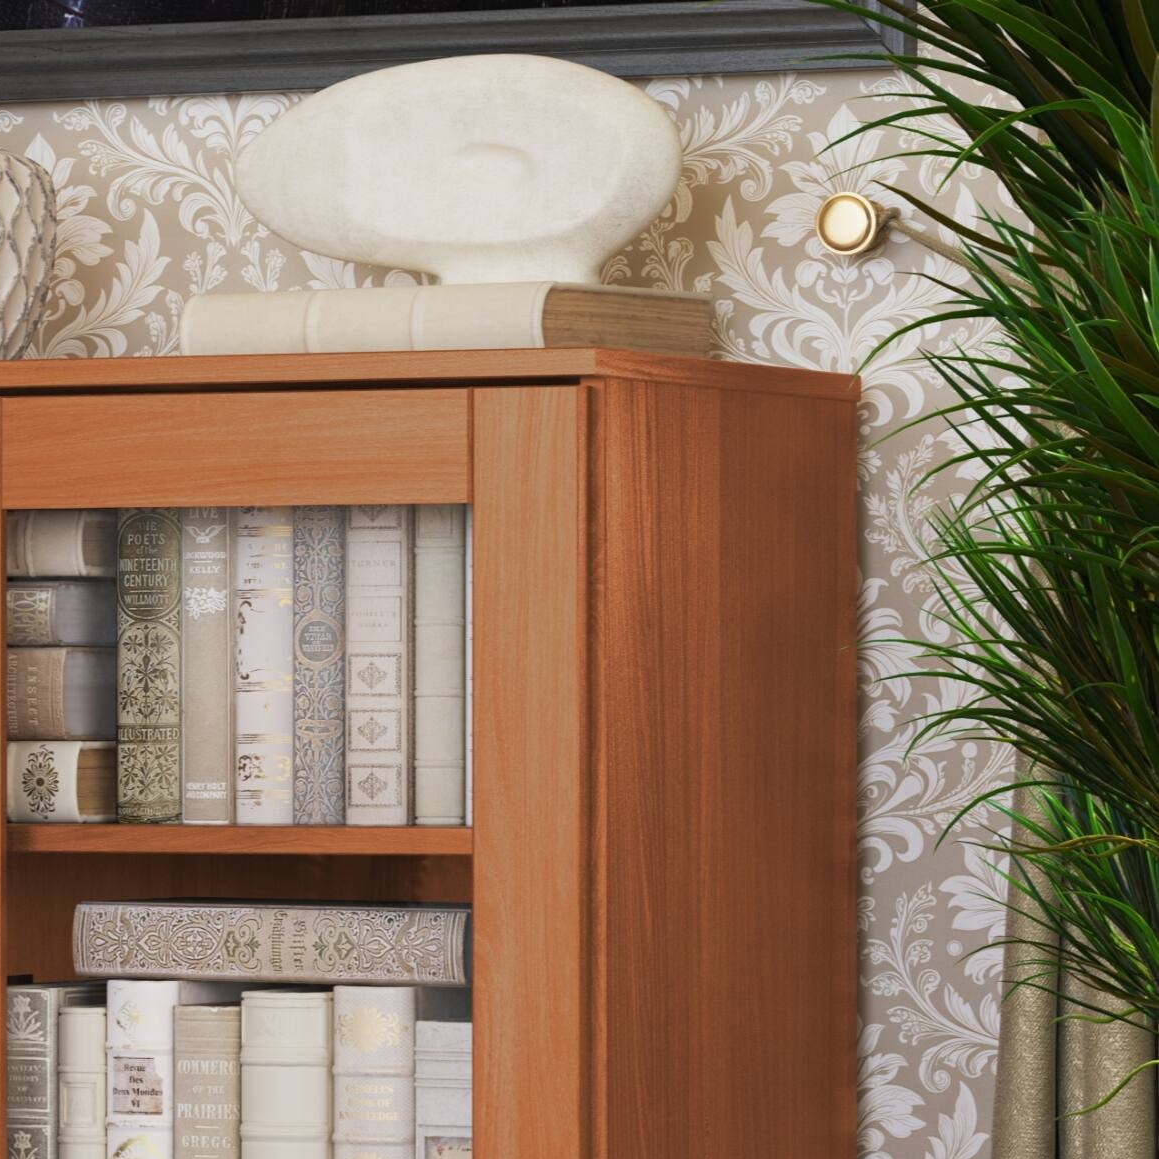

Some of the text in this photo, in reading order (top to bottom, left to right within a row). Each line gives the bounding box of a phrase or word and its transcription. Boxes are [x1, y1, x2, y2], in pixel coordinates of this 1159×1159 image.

[127, 533, 166, 545] POETS
[119, 558, 177, 572] NINETEENTH
[189, 566, 221, 574] KELLY
[123, 574, 171, 587] CENTURY
[123, 594, 170, 605] WILLMOTT
[27, 665, 39, 726] INSECT
[129, 1075, 144, 1084] Des
[207, 1085, 226, 1095] THE
[176, 1103, 240, 1121] PRAIRIES
